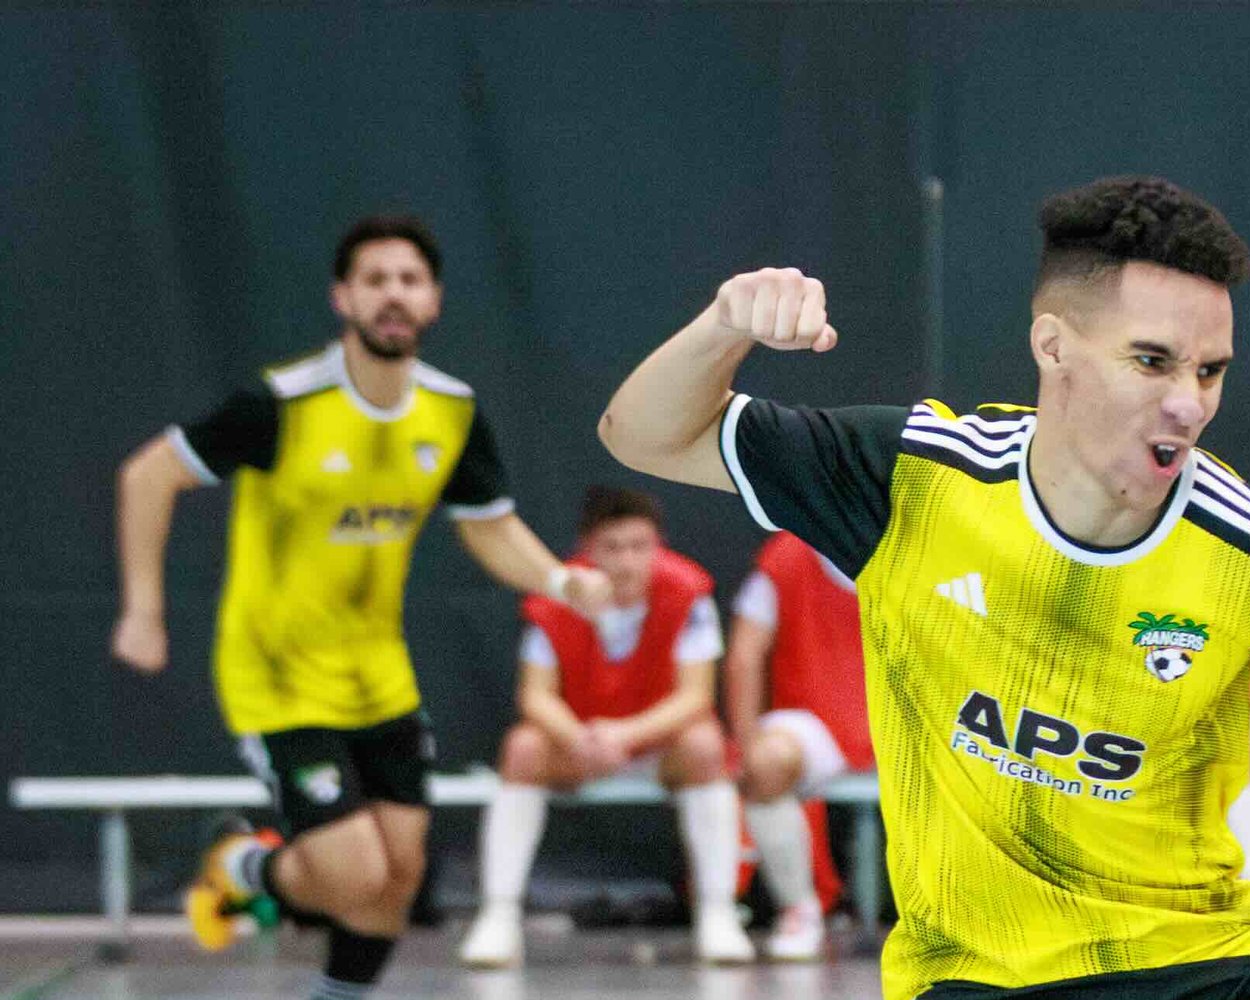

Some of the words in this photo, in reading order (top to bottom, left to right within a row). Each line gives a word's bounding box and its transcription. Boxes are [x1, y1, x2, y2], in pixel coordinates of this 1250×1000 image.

[952, 732, 1082, 794] Faication
[1092, 784, 1134, 800] Inc
[957, 690, 1146, 781] APS
